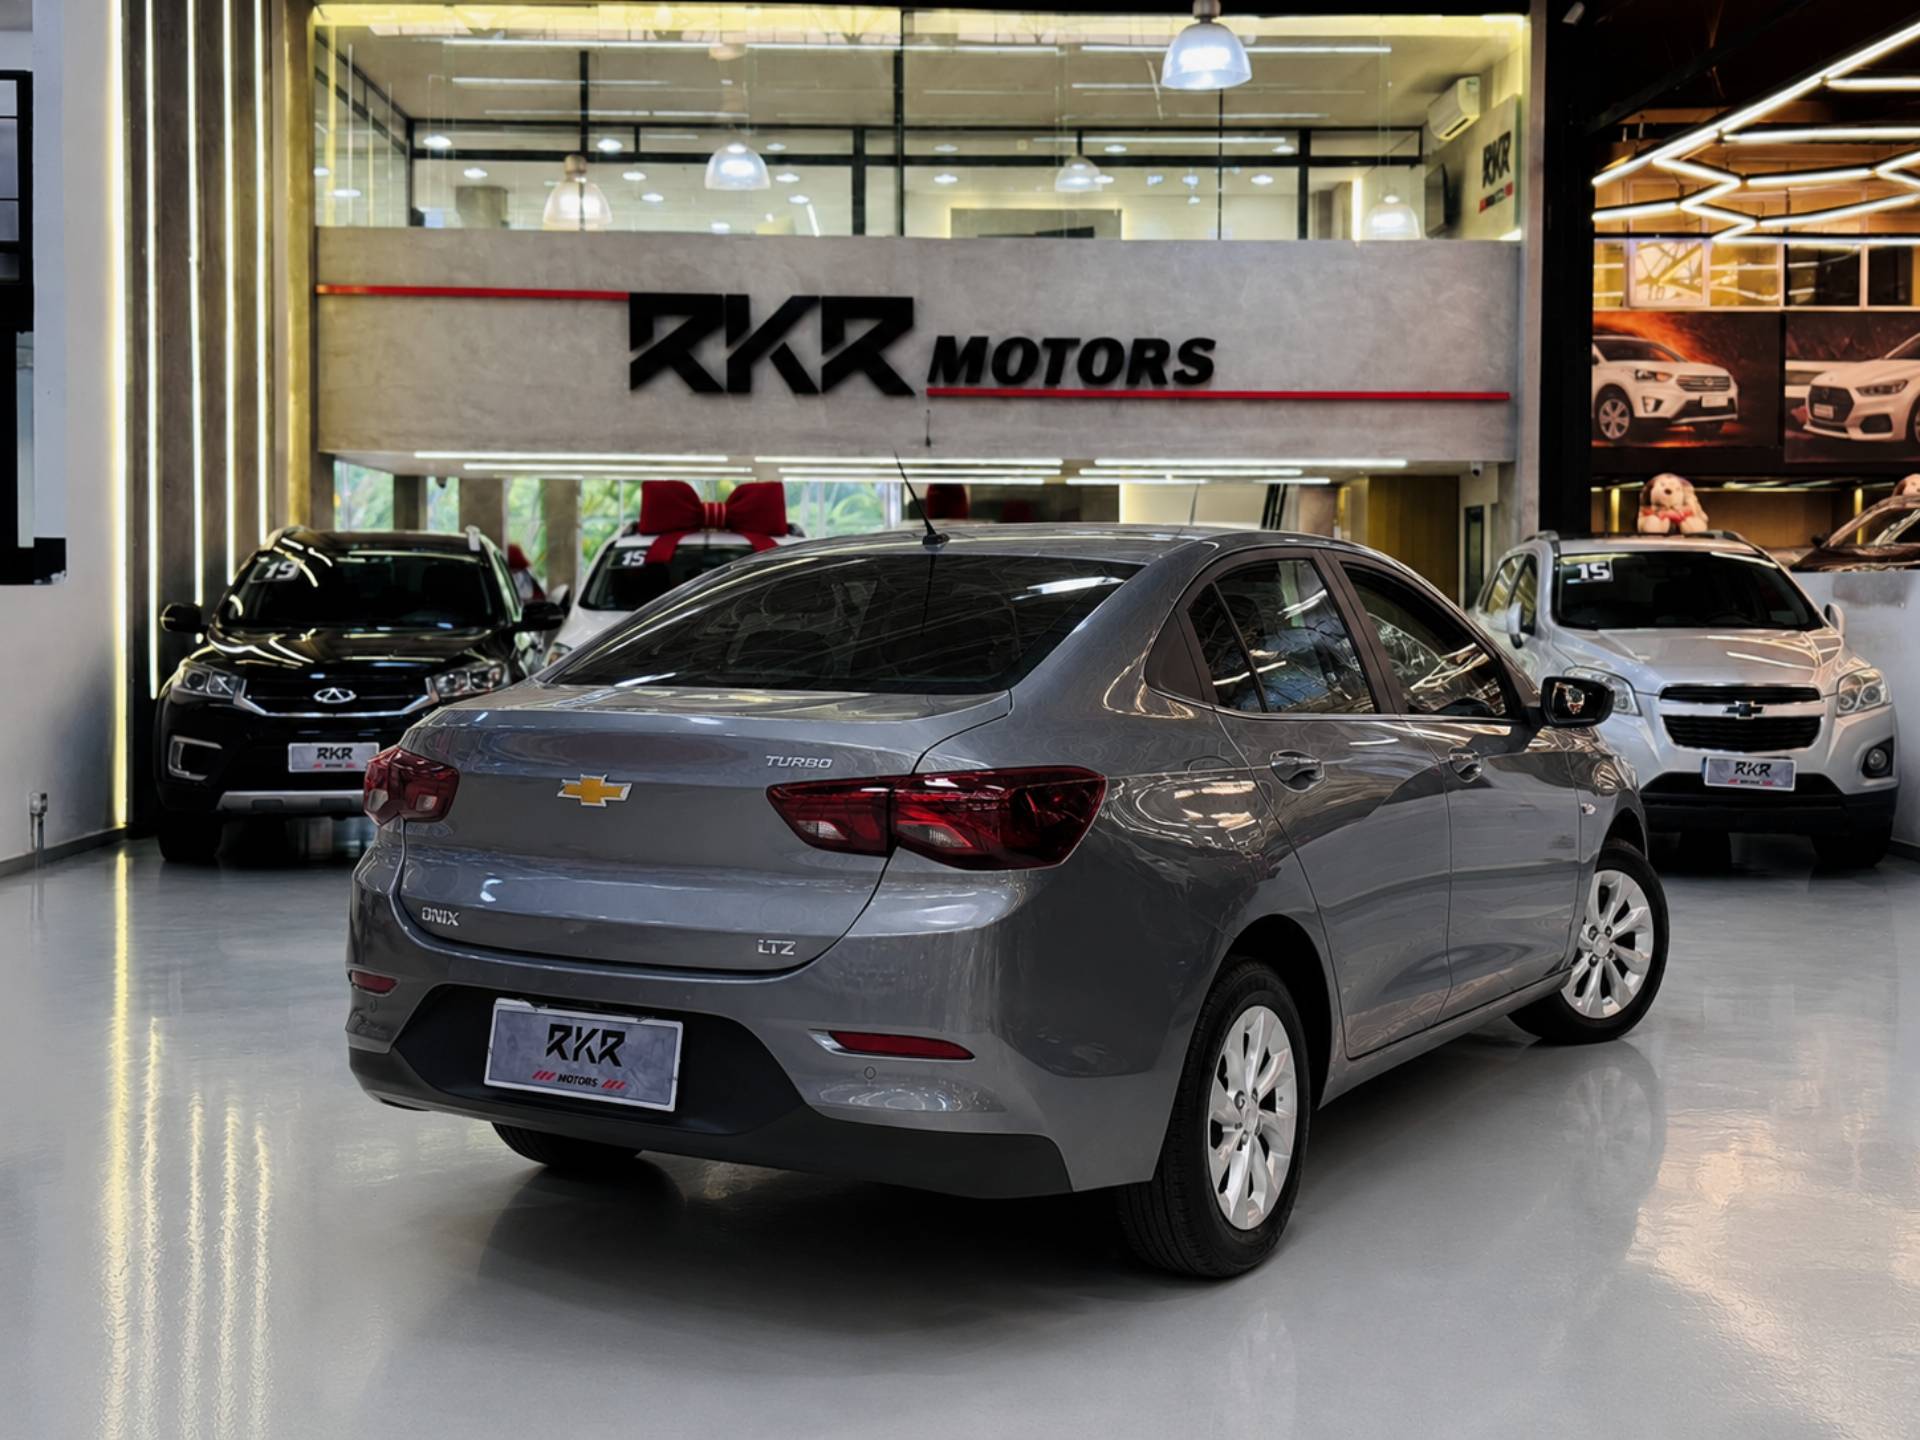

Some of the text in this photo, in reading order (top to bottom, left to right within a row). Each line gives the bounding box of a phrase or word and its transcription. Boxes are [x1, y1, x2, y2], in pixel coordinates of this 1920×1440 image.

[1482, 130, 1511, 189] RKR
[629, 293, 1217, 397] RKR MOTORS
[622, 550, 647, 567] 15
[264, 560, 299, 579] 19
[1576, 562, 1610, 580] 15
[316, 747, 353, 760] RKR
[765, 755, 832, 768] TURBO
[1735, 761, 1771, 777] RKR
[422, 907, 460, 926] ONIX
[758, 939, 796, 955] LTZ
[546, 1023, 625, 1067] RKR
[557, 1073, 598, 1087] MOTORS
